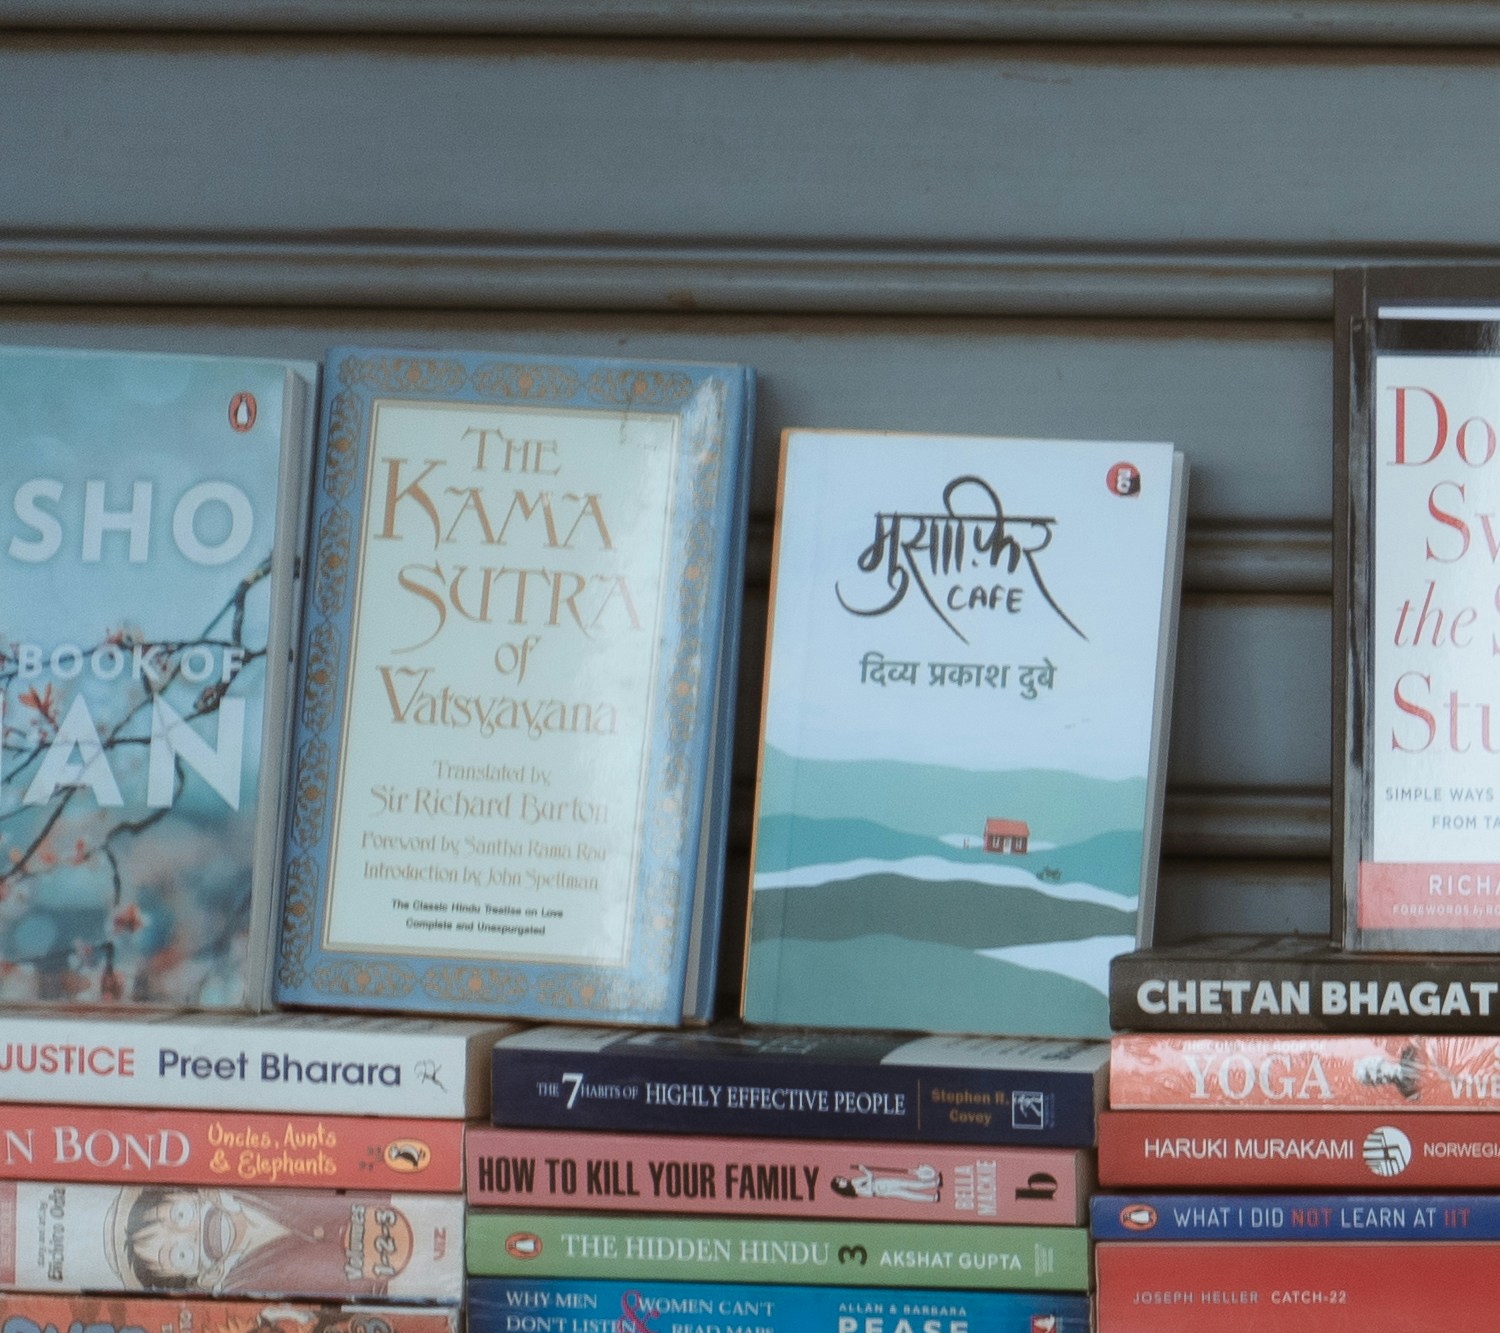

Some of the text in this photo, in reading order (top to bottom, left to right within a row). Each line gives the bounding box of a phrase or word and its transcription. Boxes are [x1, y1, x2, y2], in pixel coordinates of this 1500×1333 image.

[462, 426, 560, 475] THE
[374, 458, 614, 550] KAMA
[391, 561, 646, 654] SUTRA
[948, 586, 1023, 613] CAFE
[1393, 581, 1478, 647] the
[494, 638, 540, 685] of
[860, 651, 1057, 700] दिव्य प्रकाश दुबे
[1137, 981, 1499, 1018] CHETAN BHAGAT
[157, 1048, 401, 1089] Preet Bharara
[478, 1157, 819, 1203] HOW TO KILL YOUR FAMILY
[880, 1250, 1023, 1273] AKSHAT GUPTA
